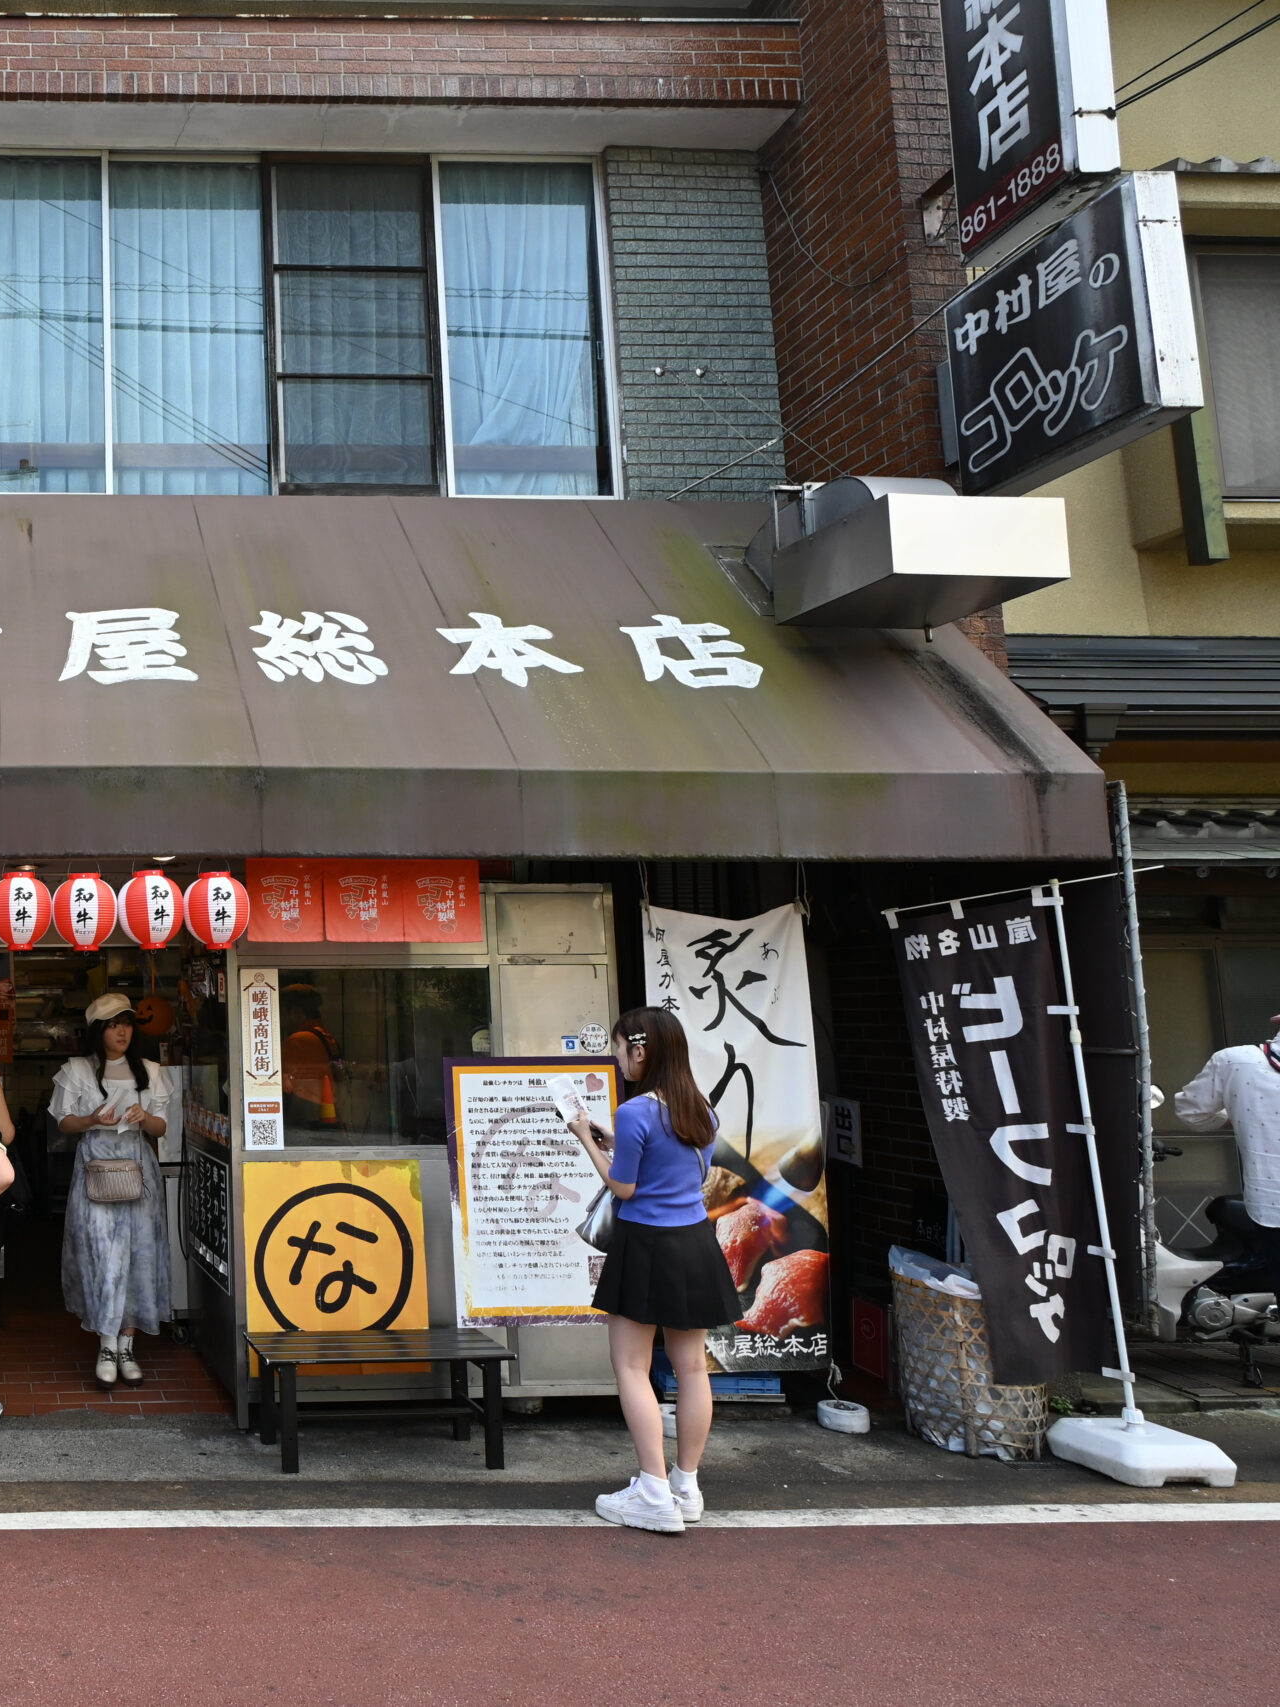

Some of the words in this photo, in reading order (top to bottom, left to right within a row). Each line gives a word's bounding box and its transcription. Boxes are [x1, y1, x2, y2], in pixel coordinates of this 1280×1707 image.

[961, 143, 1061, 245] 861-1888
[954, 238, 1121, 356] 中村屋の
[960, 324, 1129, 473] コロッケ
[13, 887, 33, 927] 和牛
[74, 887, 94, 928] 和牛
[150, 884, 170, 925] 和牛
[212, 886, 232, 927] 和牛
[252, 989, 271, 1073] 嵯峨商店街
[686, 928, 808, 1161] 炙り
[287, 1220, 379, 1314] な
